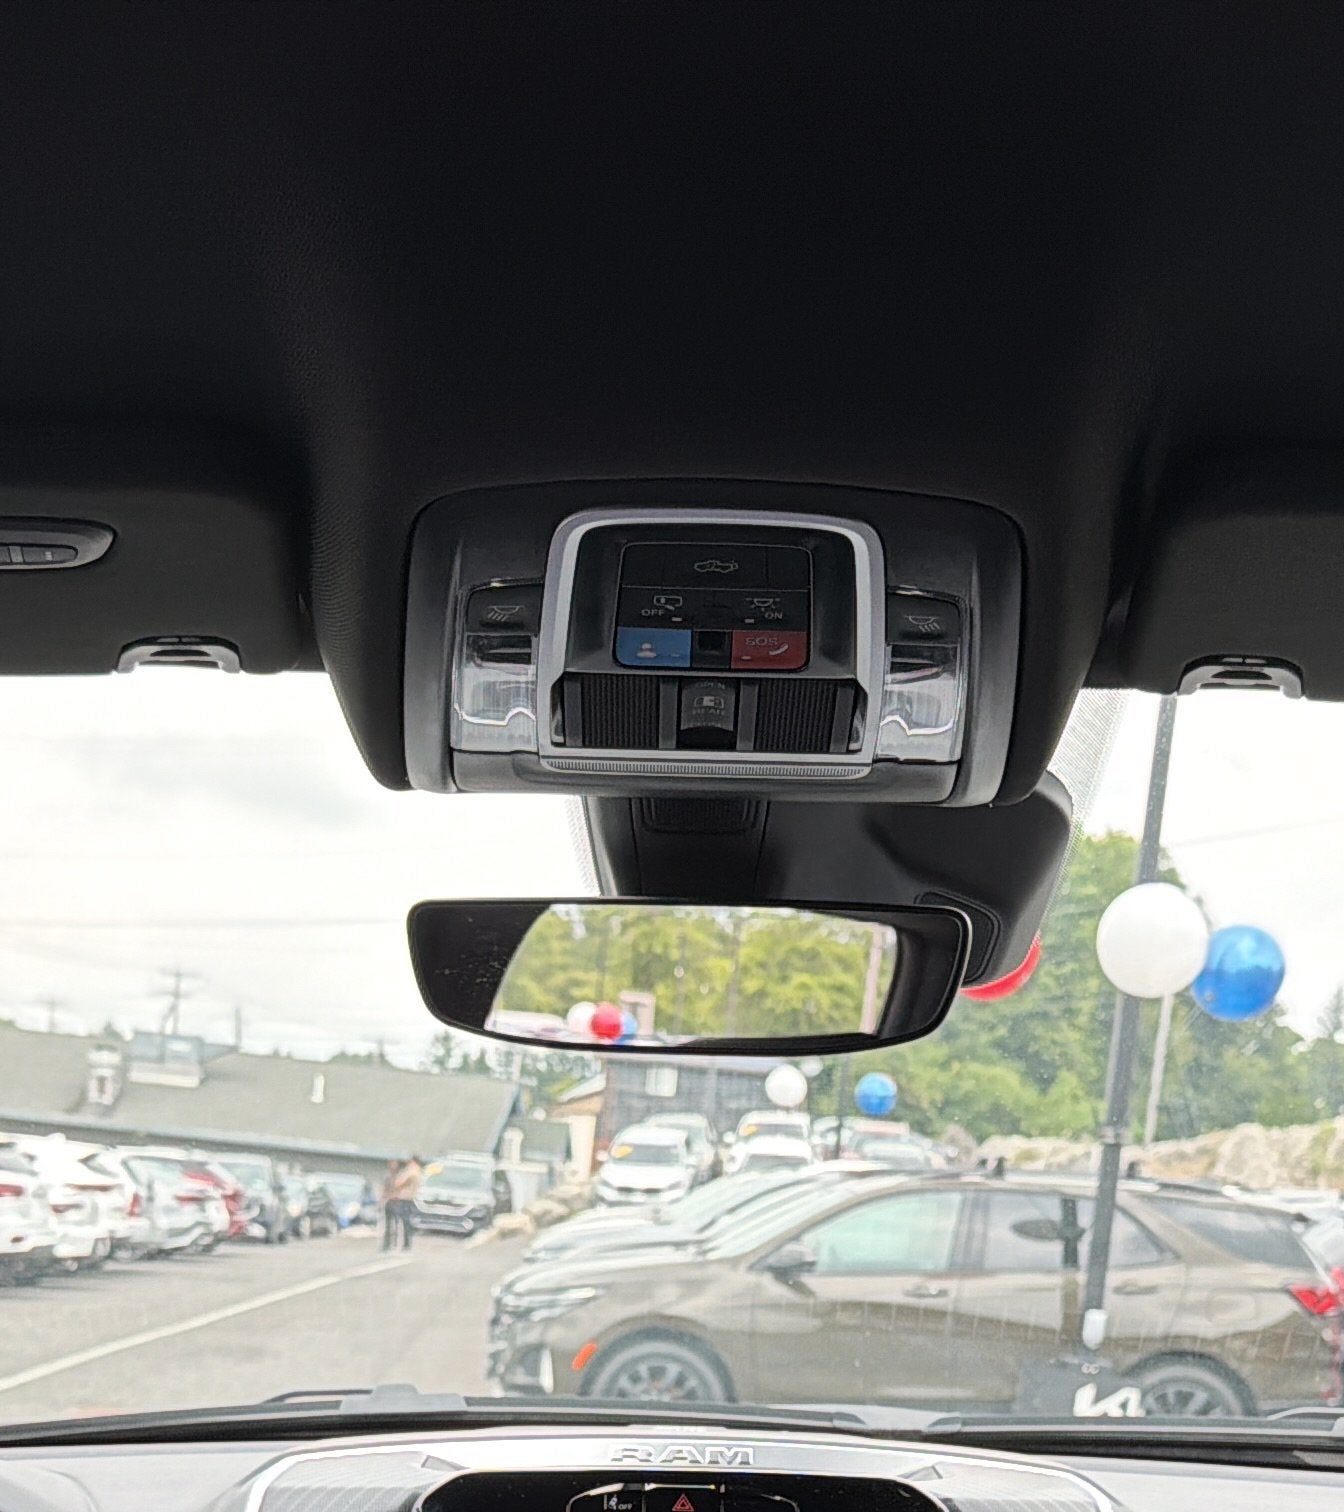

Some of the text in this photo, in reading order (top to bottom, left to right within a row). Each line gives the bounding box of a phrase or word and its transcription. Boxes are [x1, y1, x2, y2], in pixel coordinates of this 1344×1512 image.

[641, 608, 665, 617] OFF
[765, 611, 783, 620] ON
[745, 636, 778, 646] SOS
[611, 1447, 755, 1466] RAM
